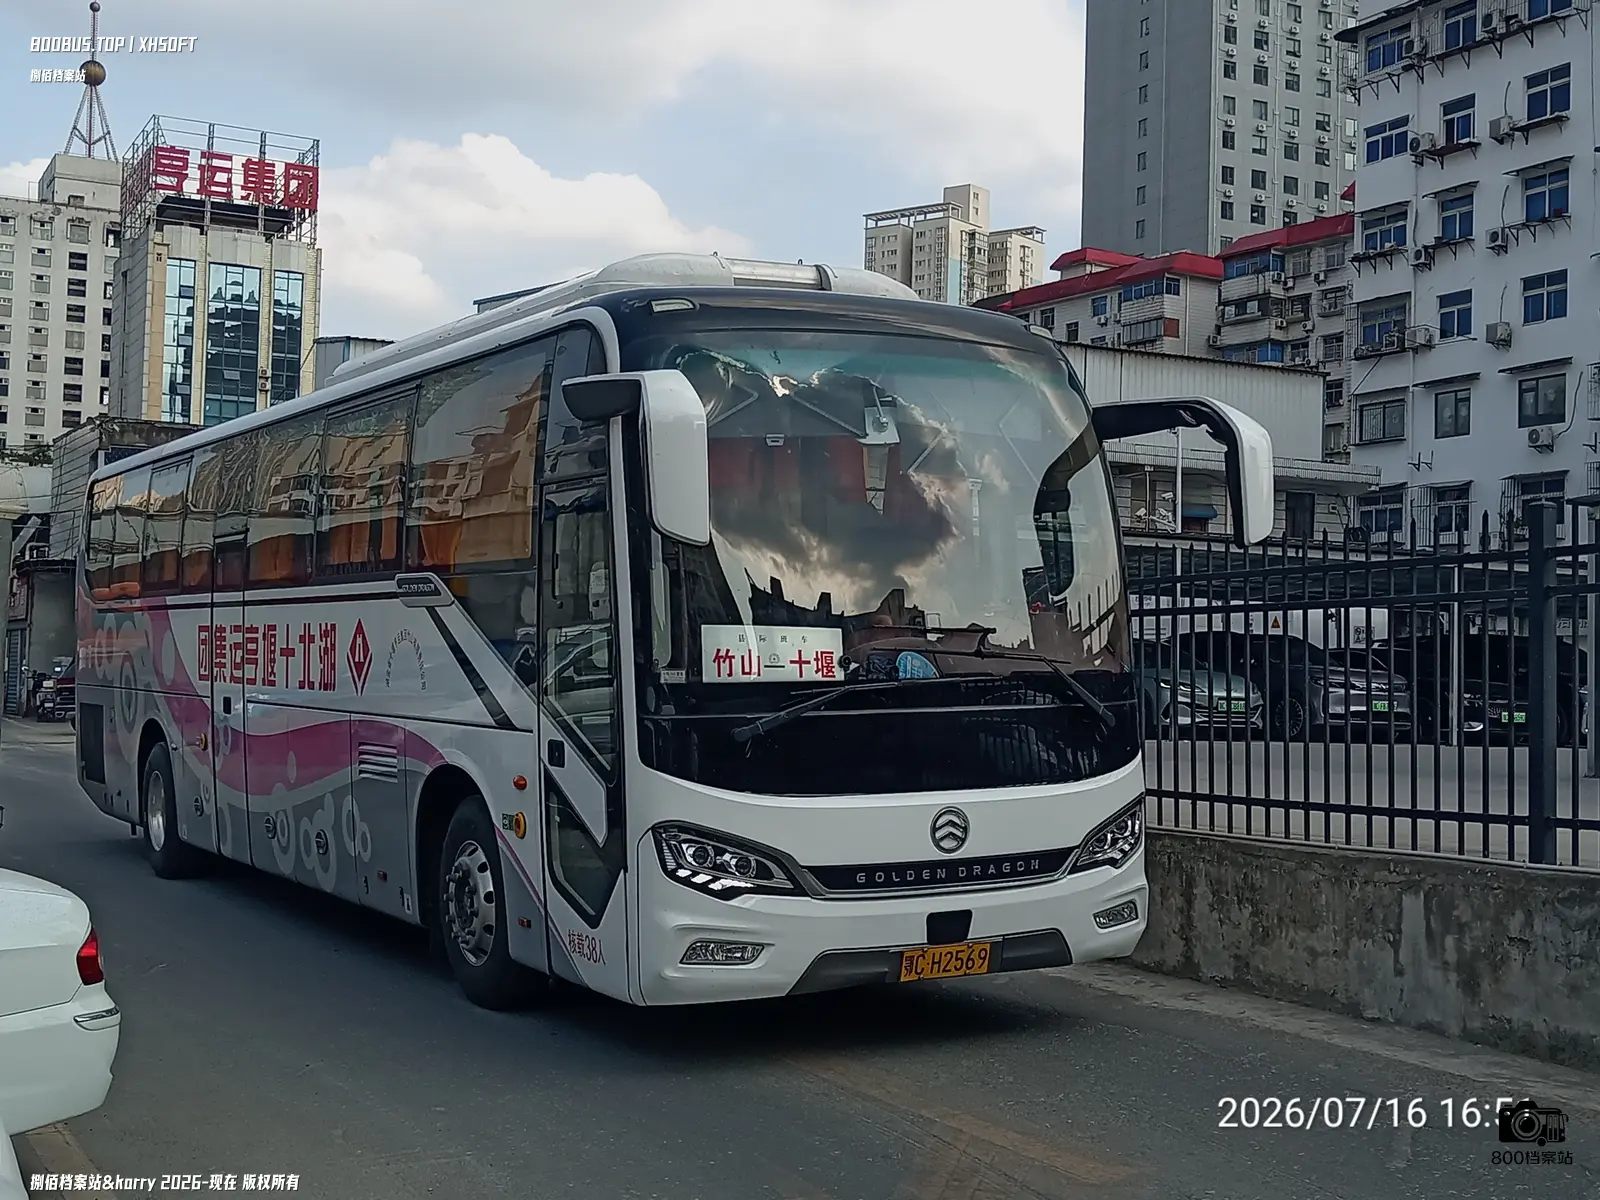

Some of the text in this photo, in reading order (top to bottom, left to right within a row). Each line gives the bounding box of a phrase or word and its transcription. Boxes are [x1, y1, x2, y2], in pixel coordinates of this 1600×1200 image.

[152, 145, 319, 211] 亨运集团
[856, 859, 1040, 884] GOLDEN DRAGON
[568, 929, 606, 966] 核载38人
